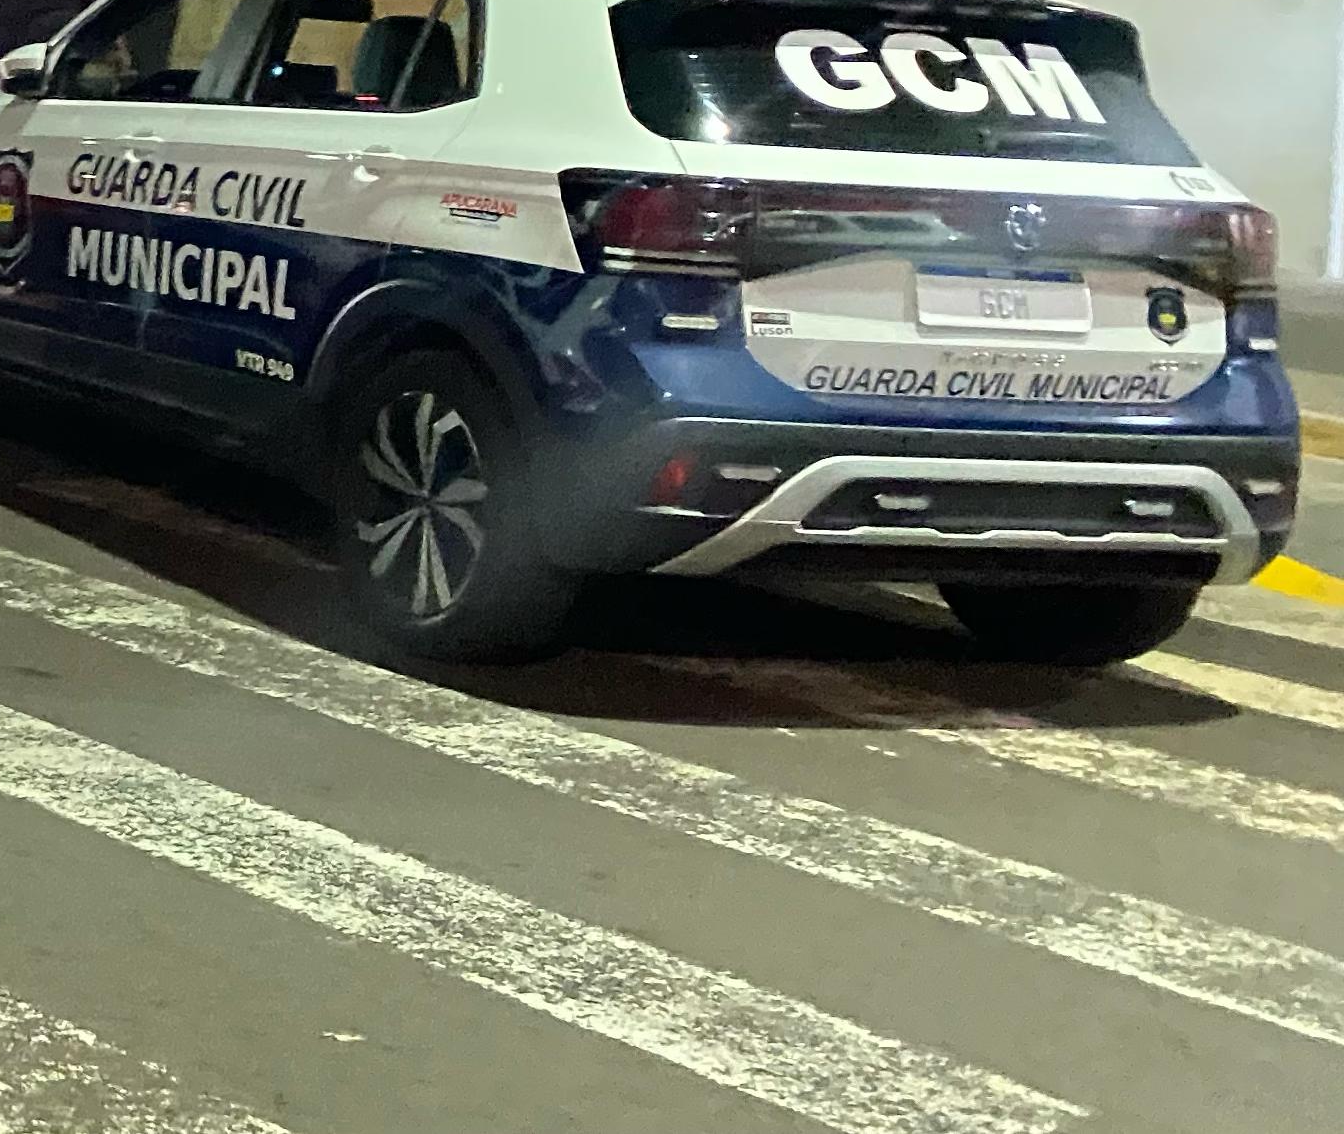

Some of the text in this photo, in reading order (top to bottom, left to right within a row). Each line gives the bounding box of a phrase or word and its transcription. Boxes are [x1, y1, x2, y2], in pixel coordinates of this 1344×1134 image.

[774, 29, 1107, 124] GCM
[67, 153, 307, 227] GUARDA CIVIL
[67, 226, 297, 320] MUNICIPAL
[805, 365, 1174, 401] GUARDA CIVIL MUNICIPAL
